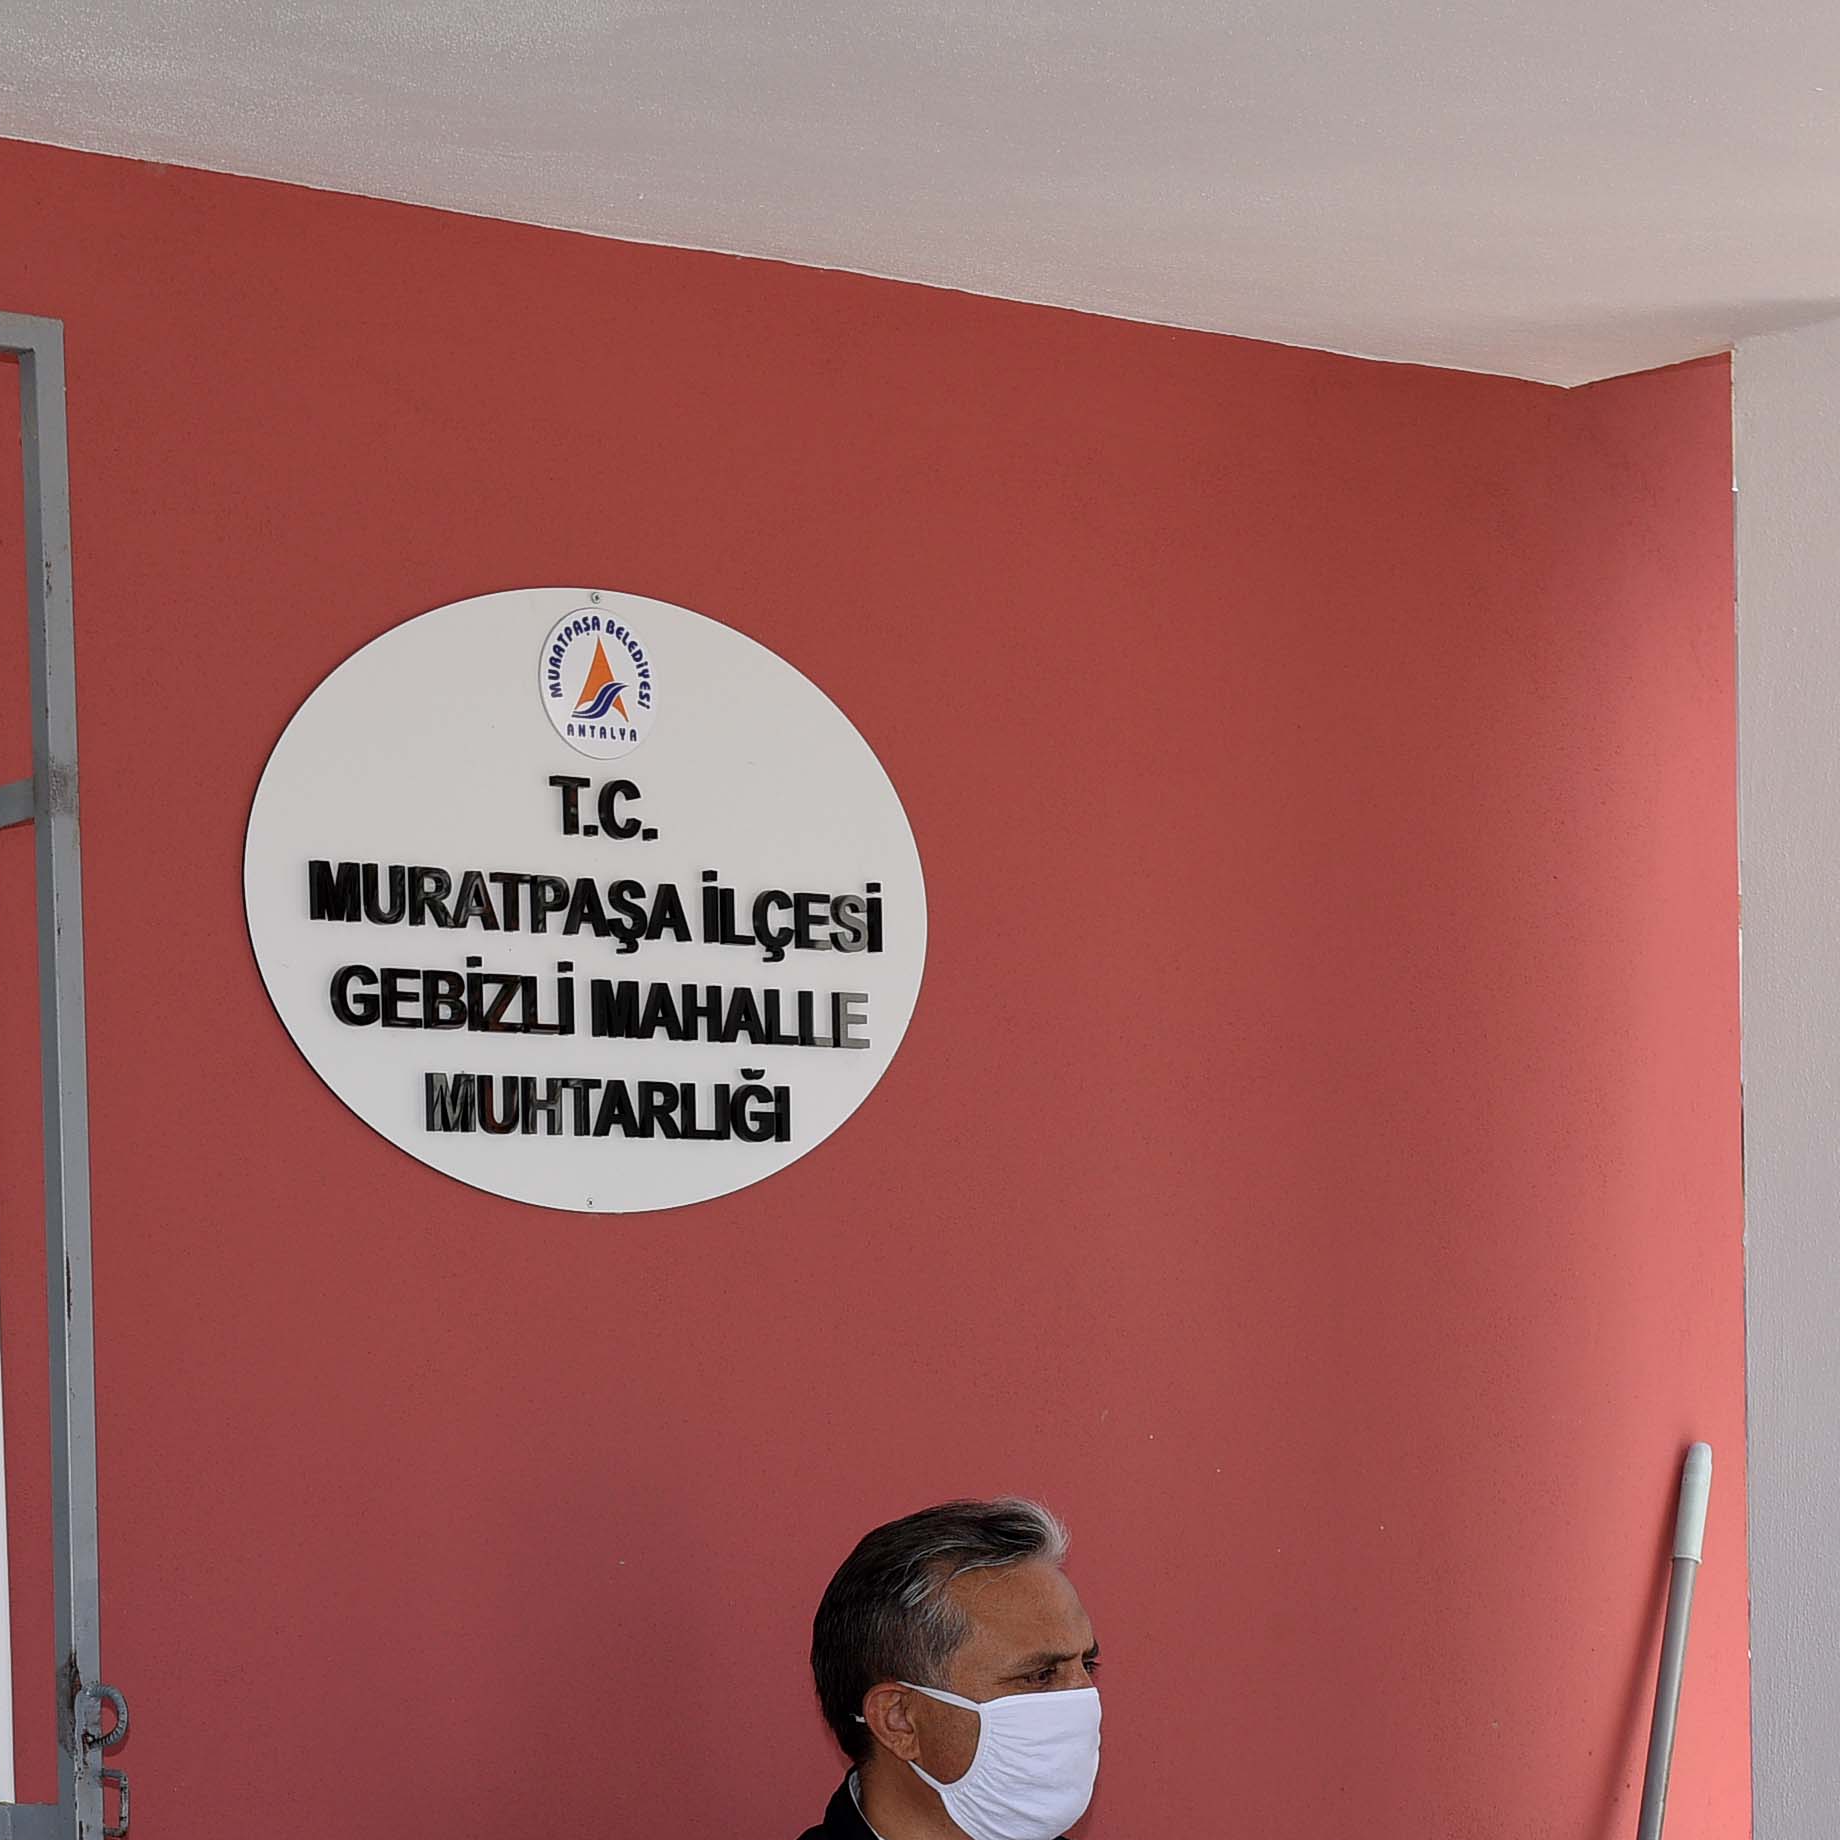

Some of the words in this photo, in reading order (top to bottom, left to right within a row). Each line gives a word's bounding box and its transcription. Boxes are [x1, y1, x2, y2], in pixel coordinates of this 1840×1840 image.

[547, 616, 601, 698] MURATPAŞA
[567, 723, 637, 742] ANTALYA
[549, 775, 658, 841] T.C.
[308, 860, 691, 953] MURATPAŞA
[702, 870, 883, 962] İLÇESİ
[330, 956, 575, 1035] GEBİZLİ
[591, 978, 871, 1048] MAHALLE
[424, 1068, 792, 1142] MUHTARLIĞI
